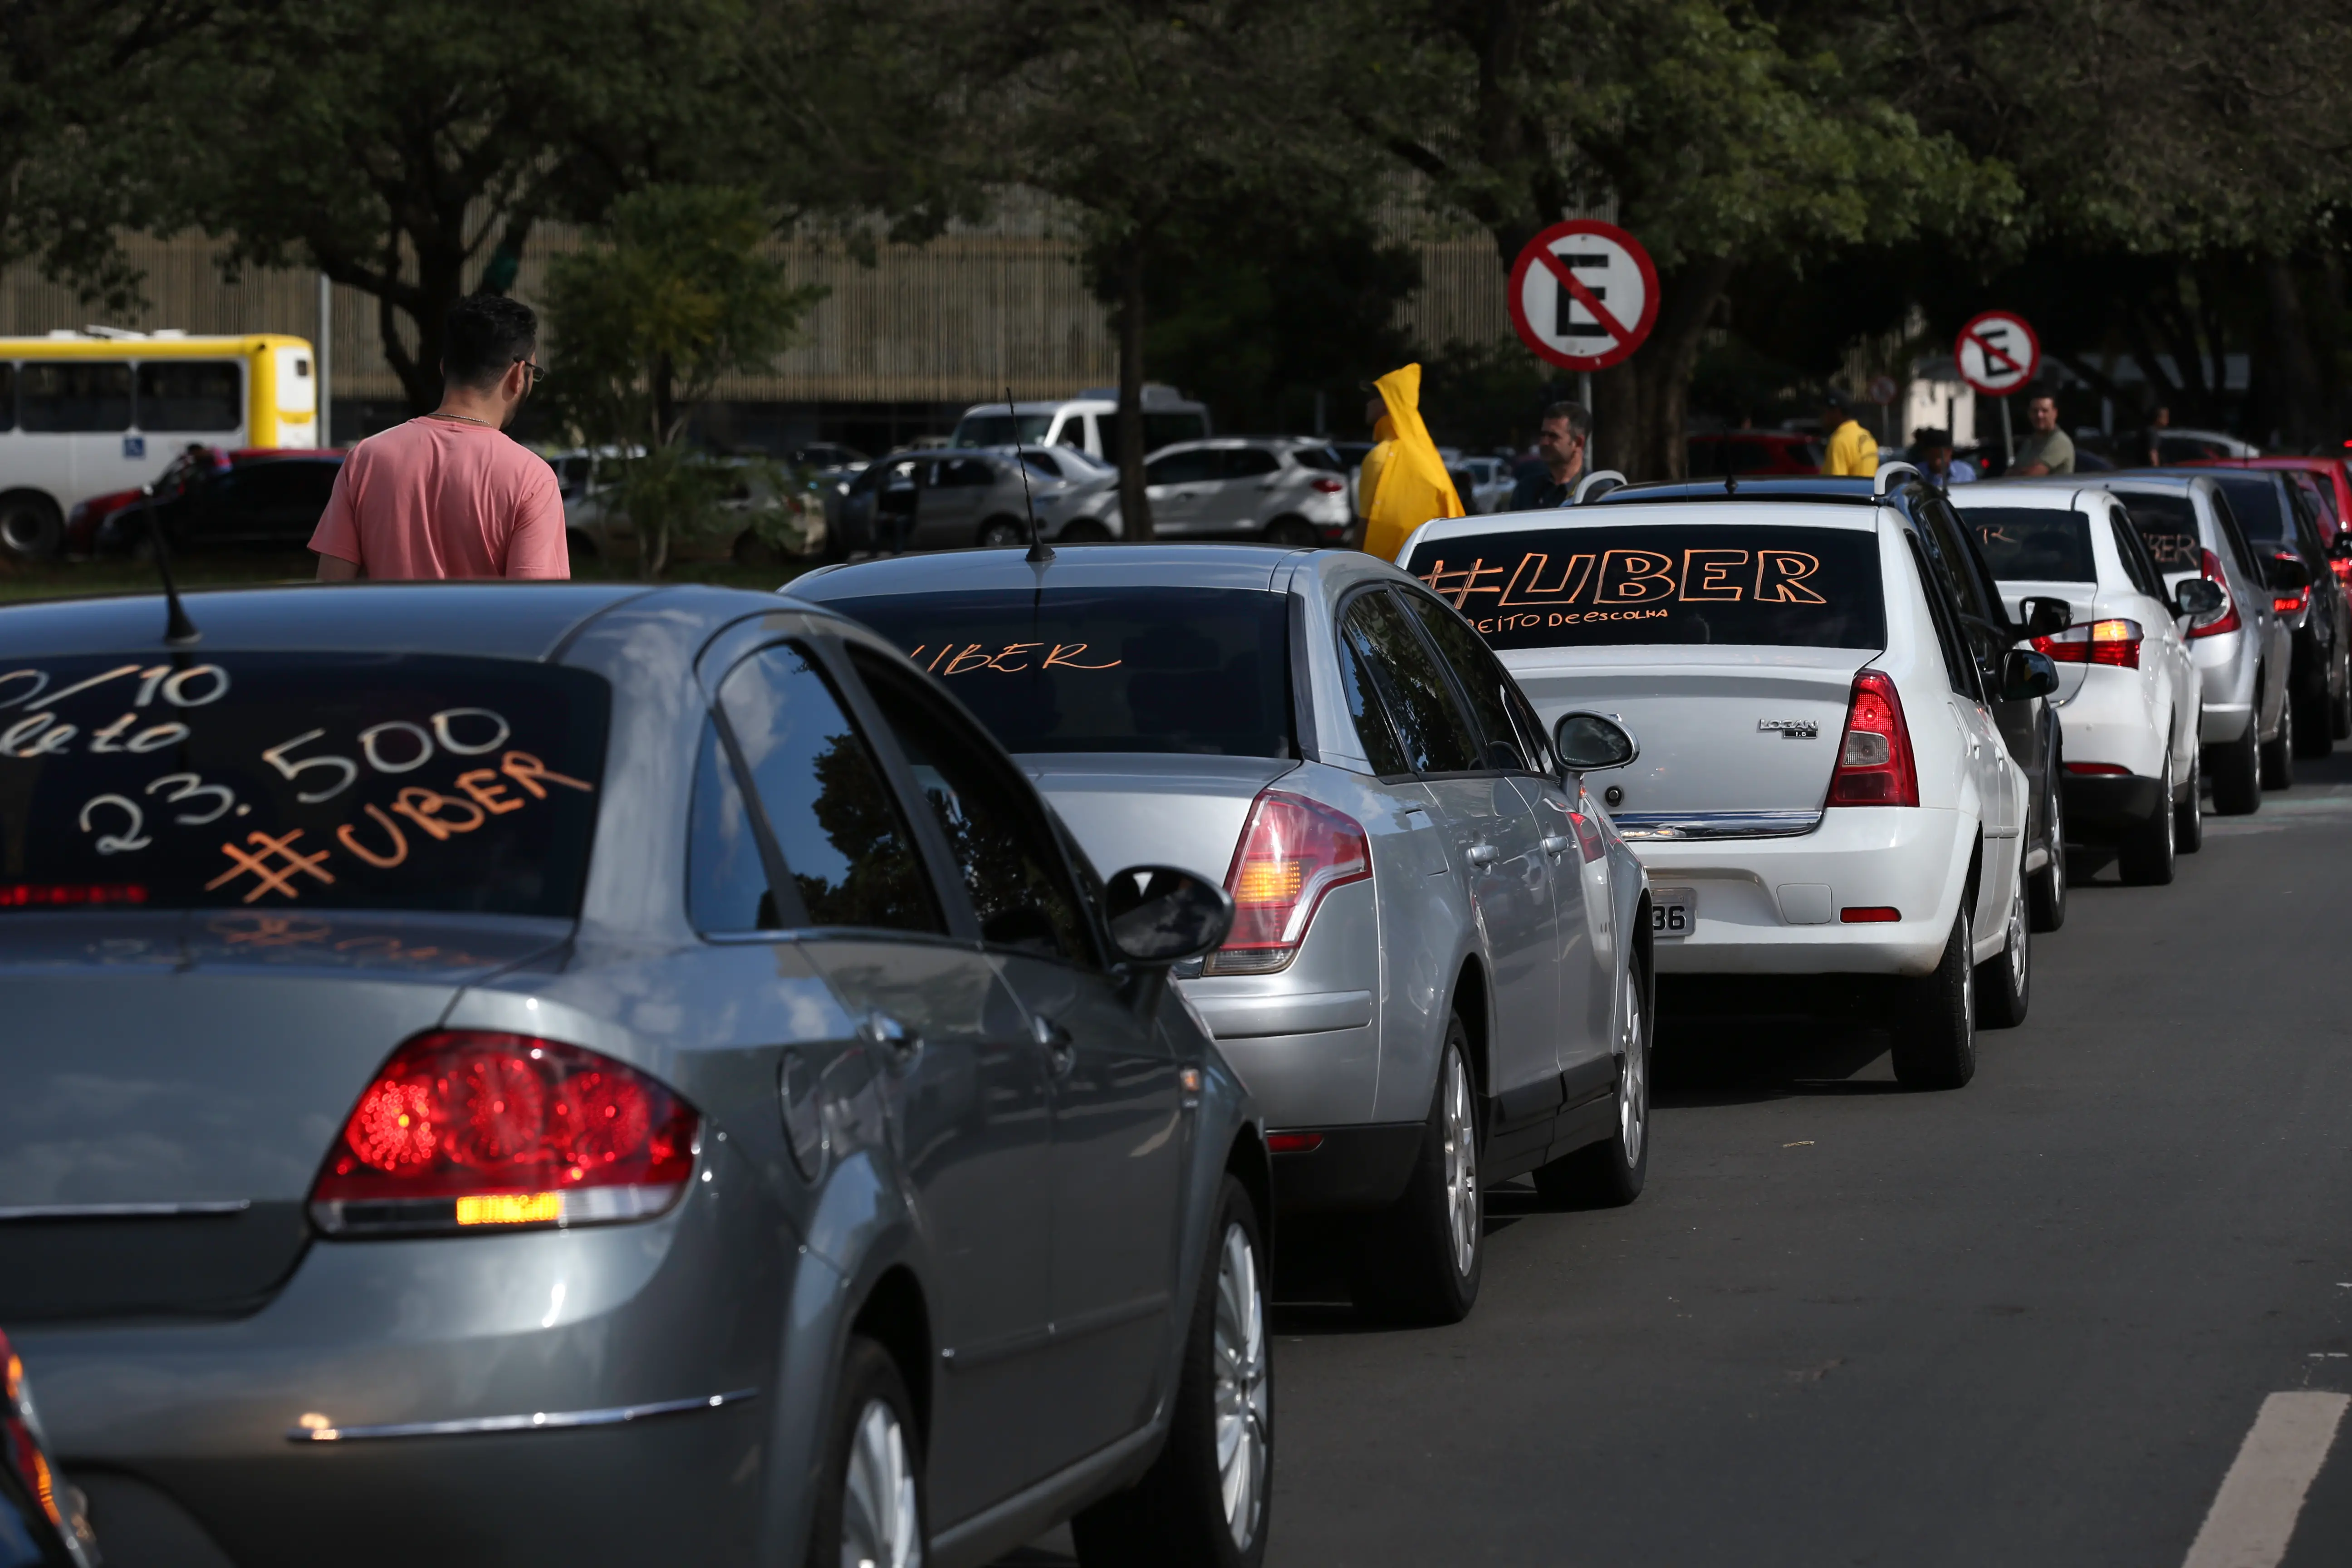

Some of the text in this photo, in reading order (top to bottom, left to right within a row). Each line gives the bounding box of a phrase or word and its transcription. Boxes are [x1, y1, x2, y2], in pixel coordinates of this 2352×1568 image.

[1556, 254, 1609, 337] E
[1979, 328, 2013, 378] E
[1417, 549, 1827, 609] #UBER
[2143, 532, 2198, 567] BER
[1759, 719, 1819, 731] LOGAN
[79, 708, 510, 855] 23.500
[205, 750, 593, 904] #UBER
